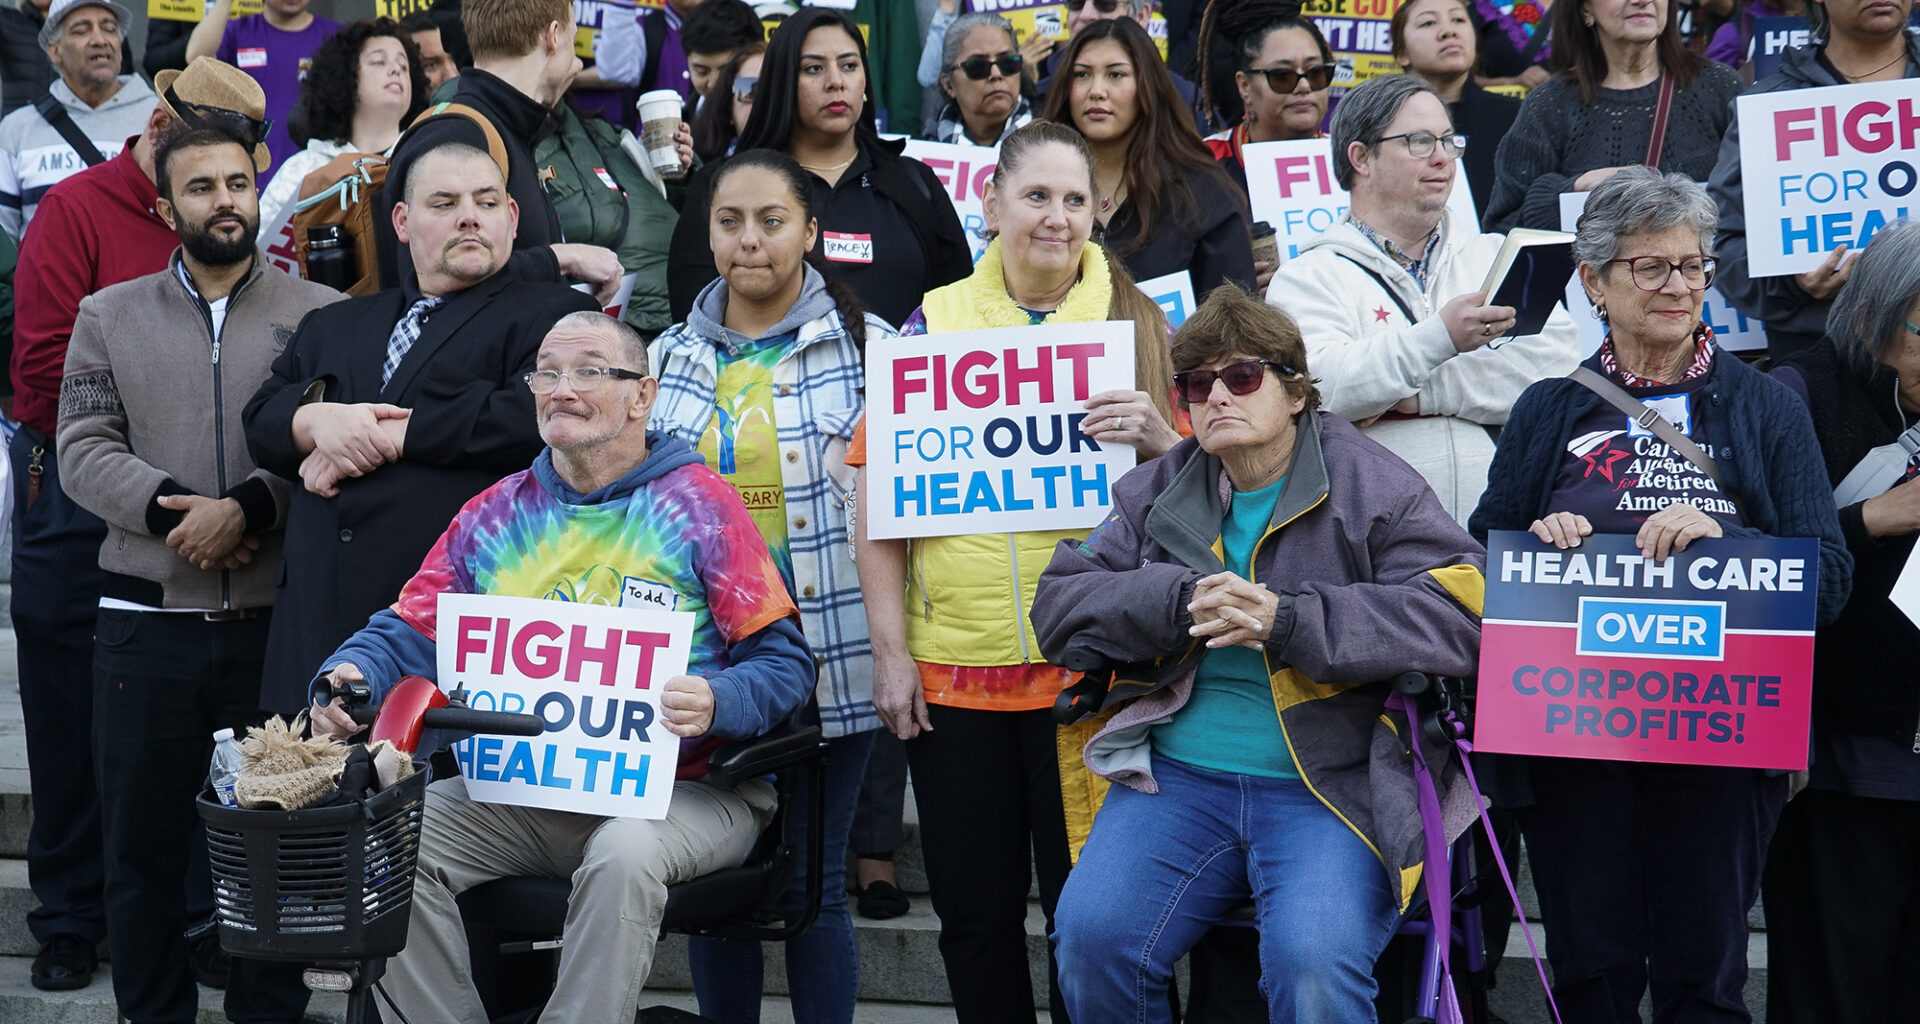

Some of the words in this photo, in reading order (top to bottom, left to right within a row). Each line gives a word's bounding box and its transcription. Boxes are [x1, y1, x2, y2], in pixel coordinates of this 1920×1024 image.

[1779, 170, 1868, 207] FOR
[892, 342, 1106, 415] FIGHT
[894, 425, 975, 464] FOR
[982, 412, 1103, 459] OUR
[893, 463, 1110, 518] HEALTH
[1615, 490, 1737, 515] Americans
[1635, 471, 1719, 493] Retired
[1500, 550, 1675, 589] HEALTH
[1687, 557, 1805, 592] CARE
[629, 585, 666, 607] Todd
[1595, 612, 1708, 646] OVER
[455, 615, 671, 691] FIGHT
[1511, 664, 1782, 708] CORPORATE
[533, 691, 655, 743] OUR
[1544, 704, 1746, 745] PROFITS!
[456, 737, 651, 798] HEALTH
